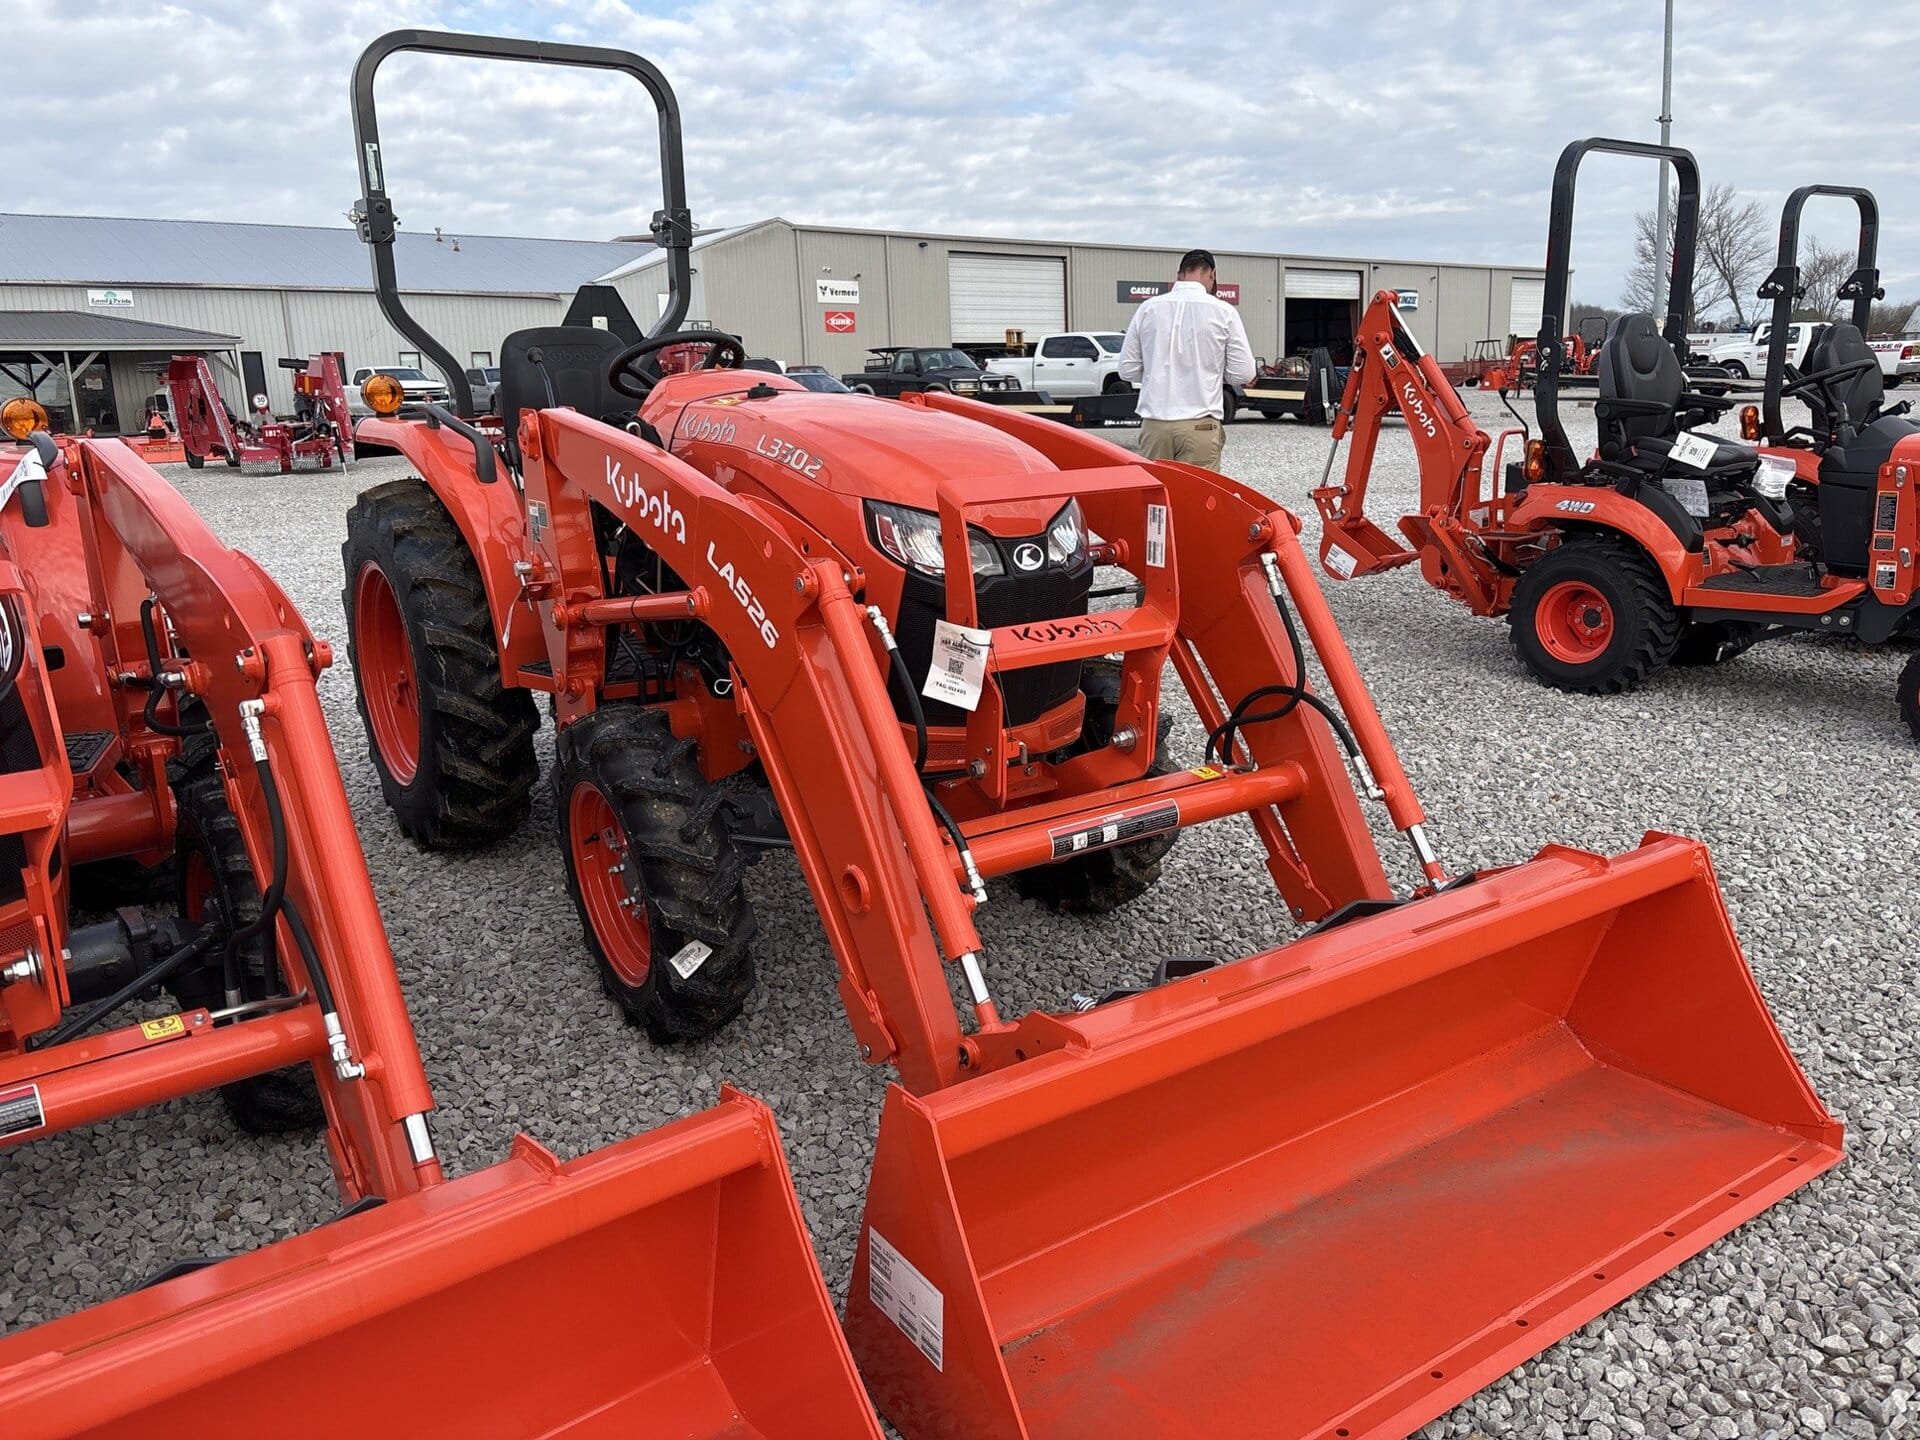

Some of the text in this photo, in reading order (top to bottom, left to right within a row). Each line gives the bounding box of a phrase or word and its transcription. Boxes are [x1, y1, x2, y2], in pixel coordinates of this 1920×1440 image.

[829, 287, 858, 297] Vermeer
[1130, 286, 1151, 295] CASE
[1216, 290, 1236, 298] OWER
[1403, 381, 1436, 438] Kubota
[680, 412, 825, 480] Kubota L3302
[605, 455, 686, 545] Kubota
[1554, 499, 1597, 514] 4WD
[706, 540, 780, 649] LA526
[1010, 618, 1123, 643] Kubota
[908, 1291, 917, 1306] 10
